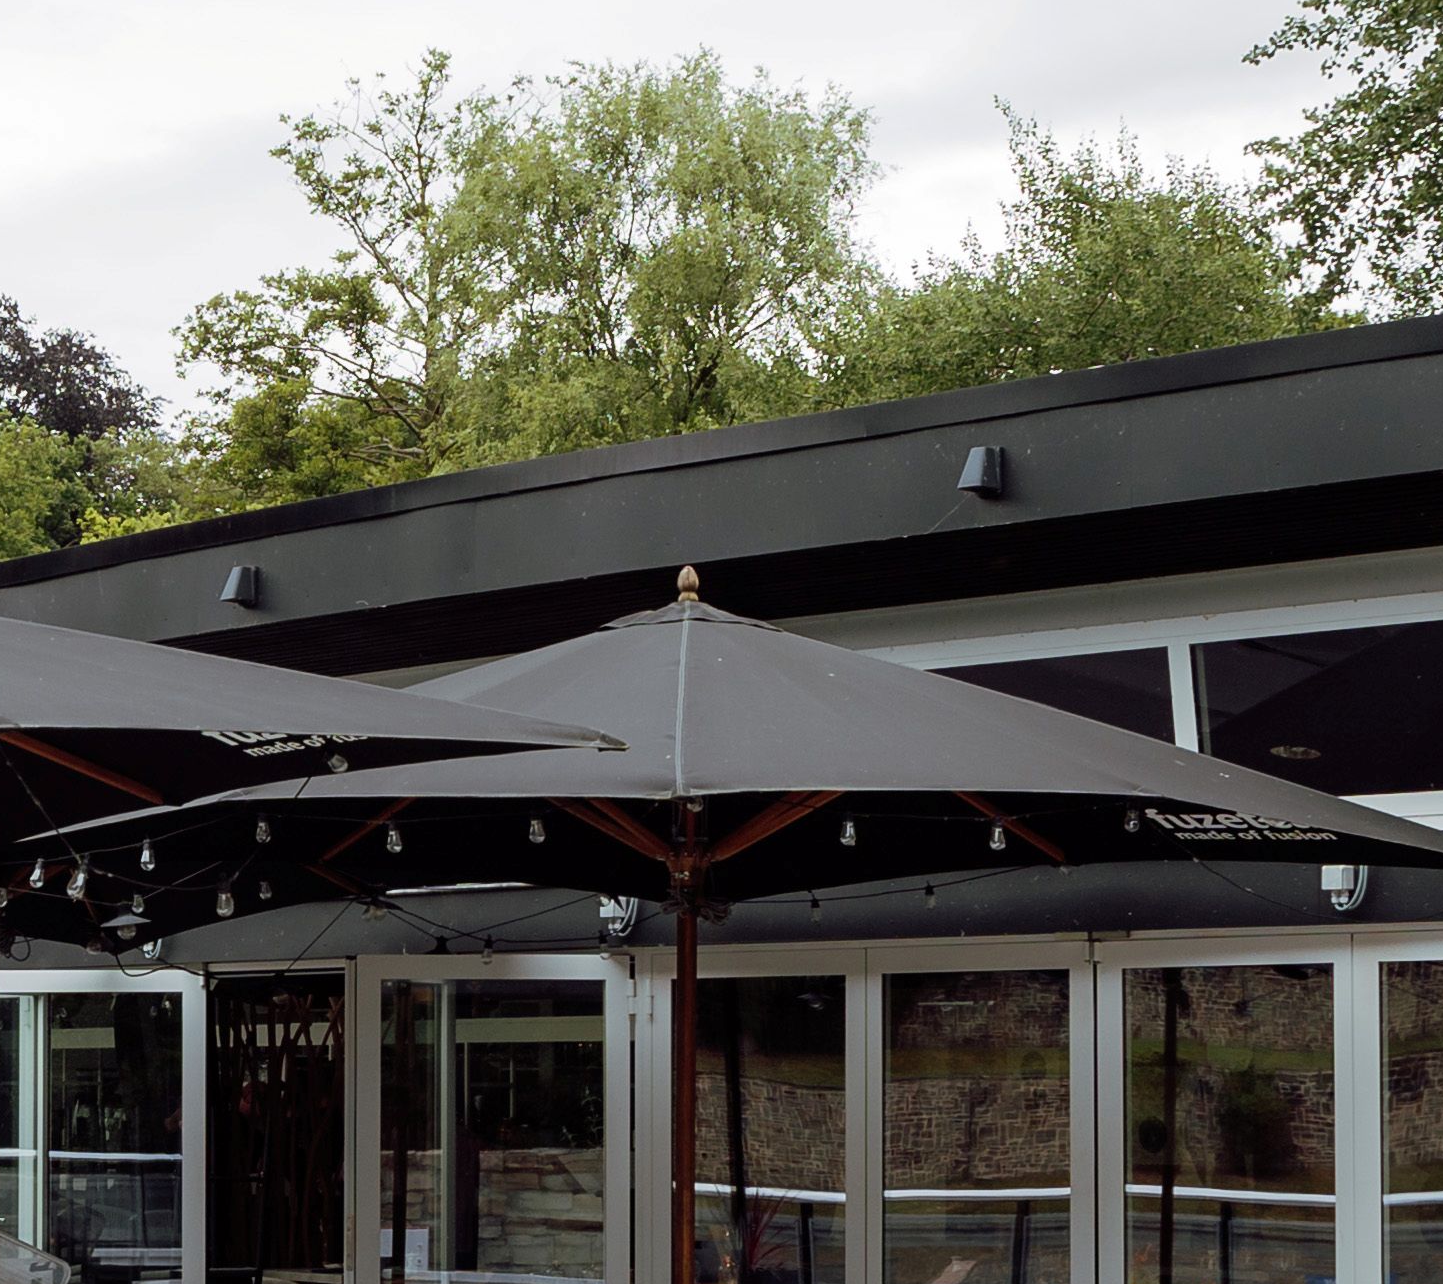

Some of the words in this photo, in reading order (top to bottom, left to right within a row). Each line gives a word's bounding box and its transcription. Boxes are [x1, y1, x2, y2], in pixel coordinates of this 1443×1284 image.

[242, 740, 306, 757] made
[1144, 808, 1312, 830] fuzete
[1174, 830, 1236, 840] made
[1237, 830, 1263, 840] of
[1263, 830, 1338, 840] fusion
